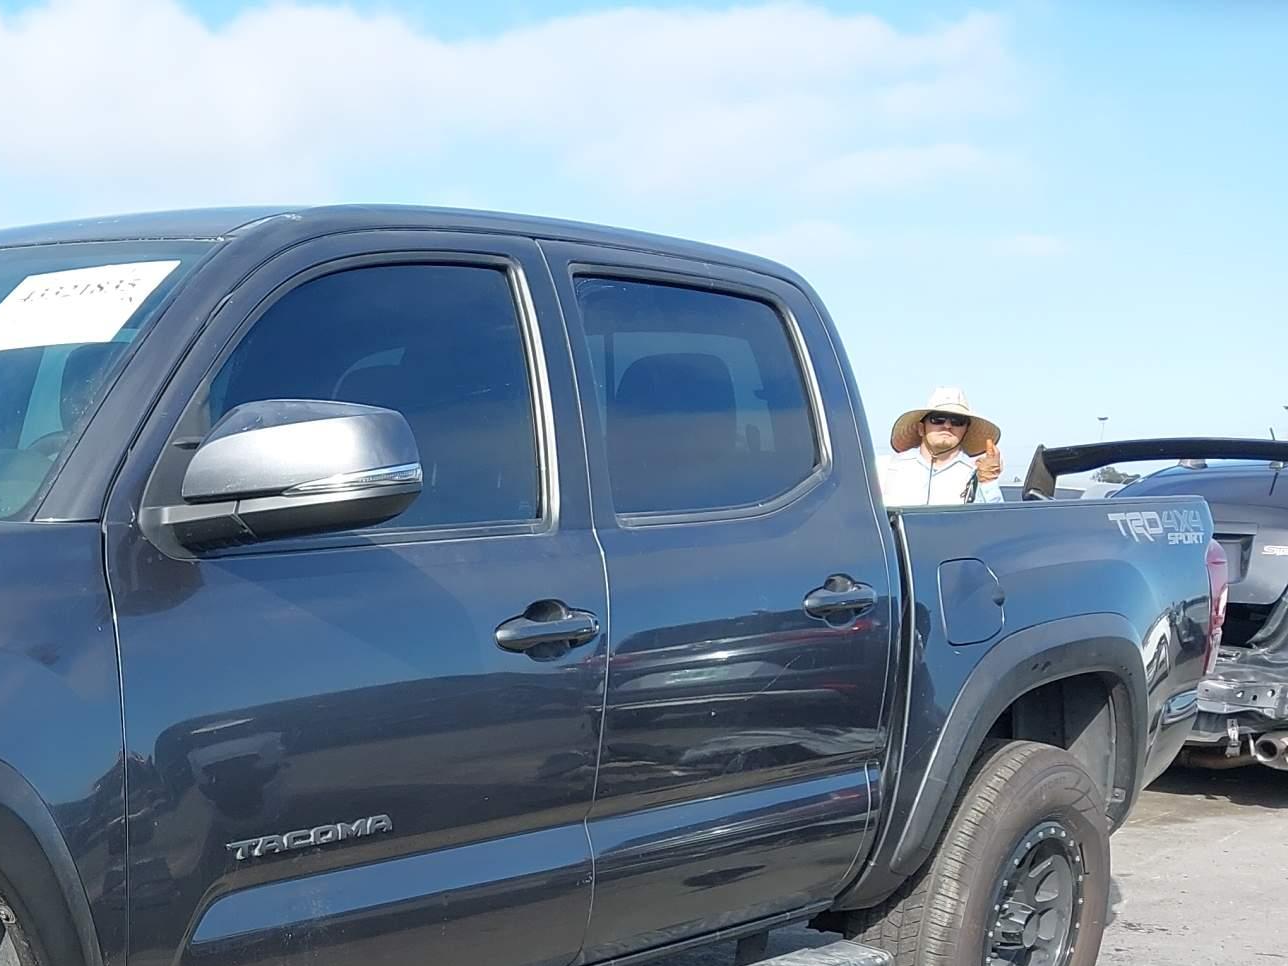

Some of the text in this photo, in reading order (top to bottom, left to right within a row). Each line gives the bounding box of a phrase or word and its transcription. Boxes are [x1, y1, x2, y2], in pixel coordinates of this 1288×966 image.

[1107, 511, 1164, 542] TRD
[1168, 532, 1204, 544] SPORT
[226, 814, 393, 860] TACOMA
